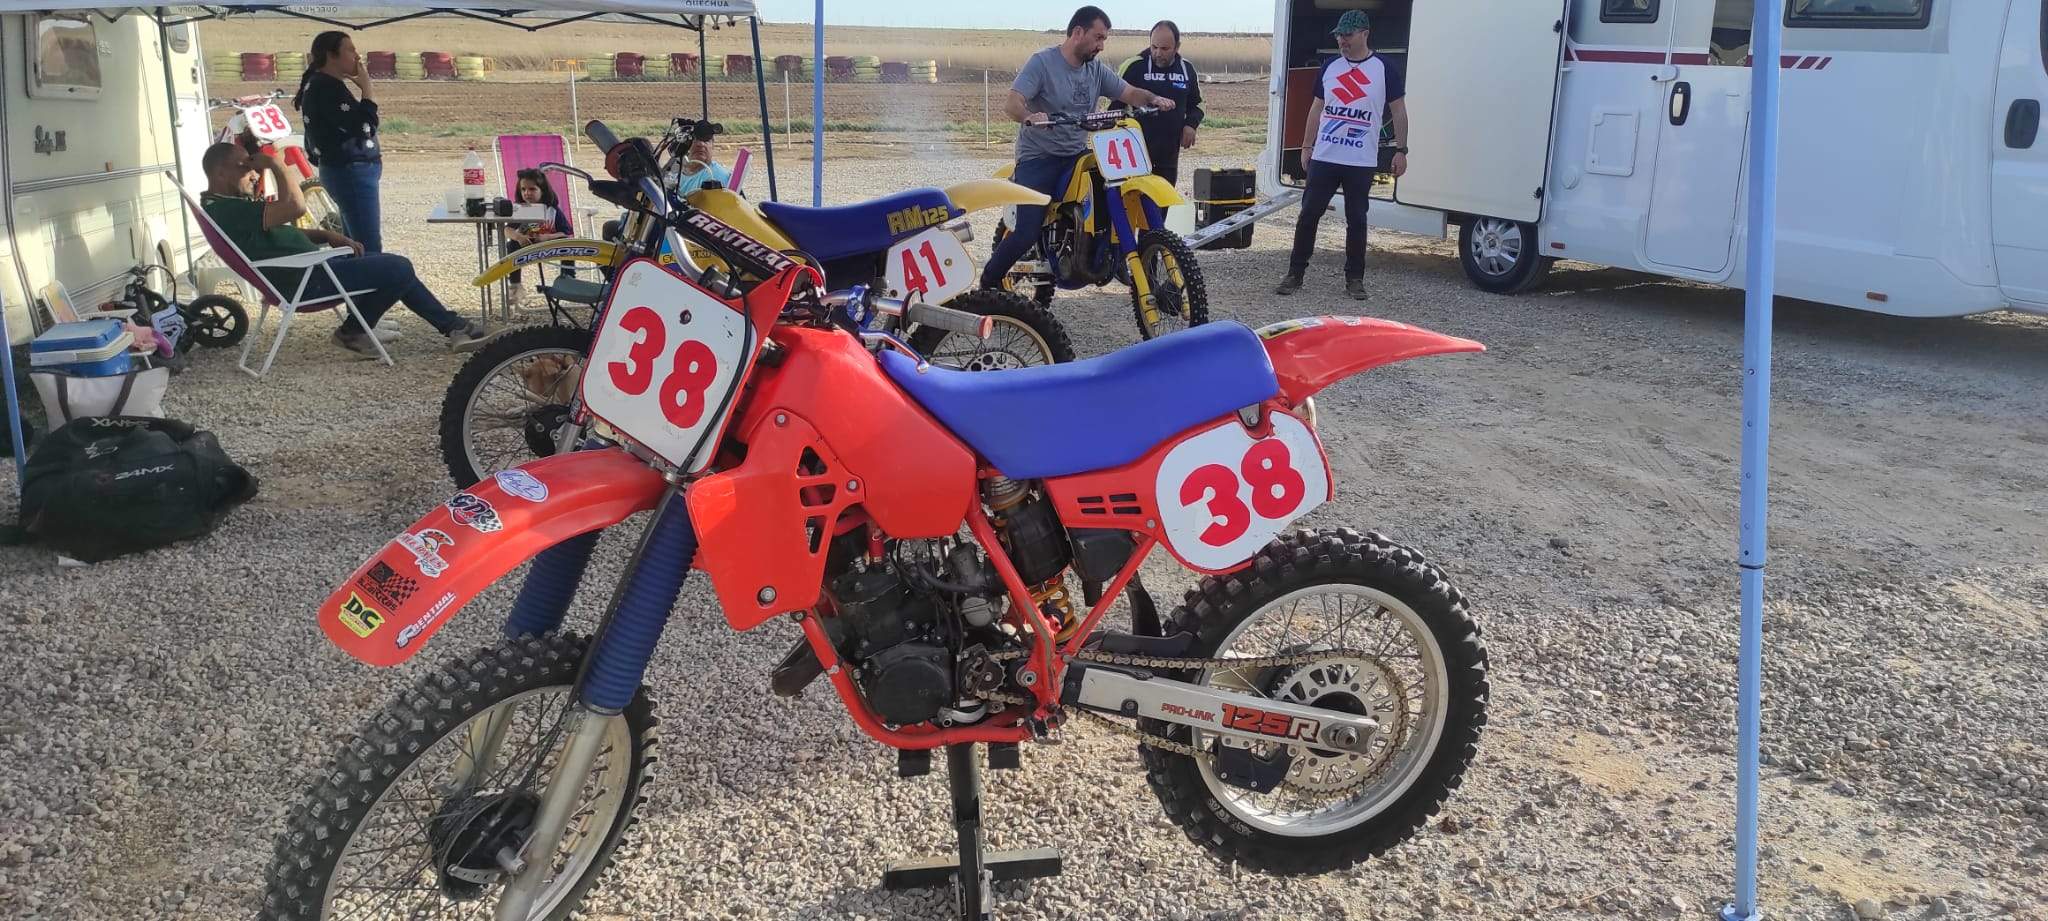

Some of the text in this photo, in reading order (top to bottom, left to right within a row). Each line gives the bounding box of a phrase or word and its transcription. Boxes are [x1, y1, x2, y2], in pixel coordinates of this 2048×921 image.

[251, 106, 286, 133] 38
[1324, 105, 1372, 121] SUZUKI
[1107, 138, 1137, 169] 41
[687, 213, 793, 271] RENTHAL
[901, 239, 947, 294] 41
[607, 306, 718, 429] 38
[1179, 438, 1306, 547] 38
[343, 597, 380, 630] DC
[1161, 702, 1321, 744] PRO-LINK 125R
